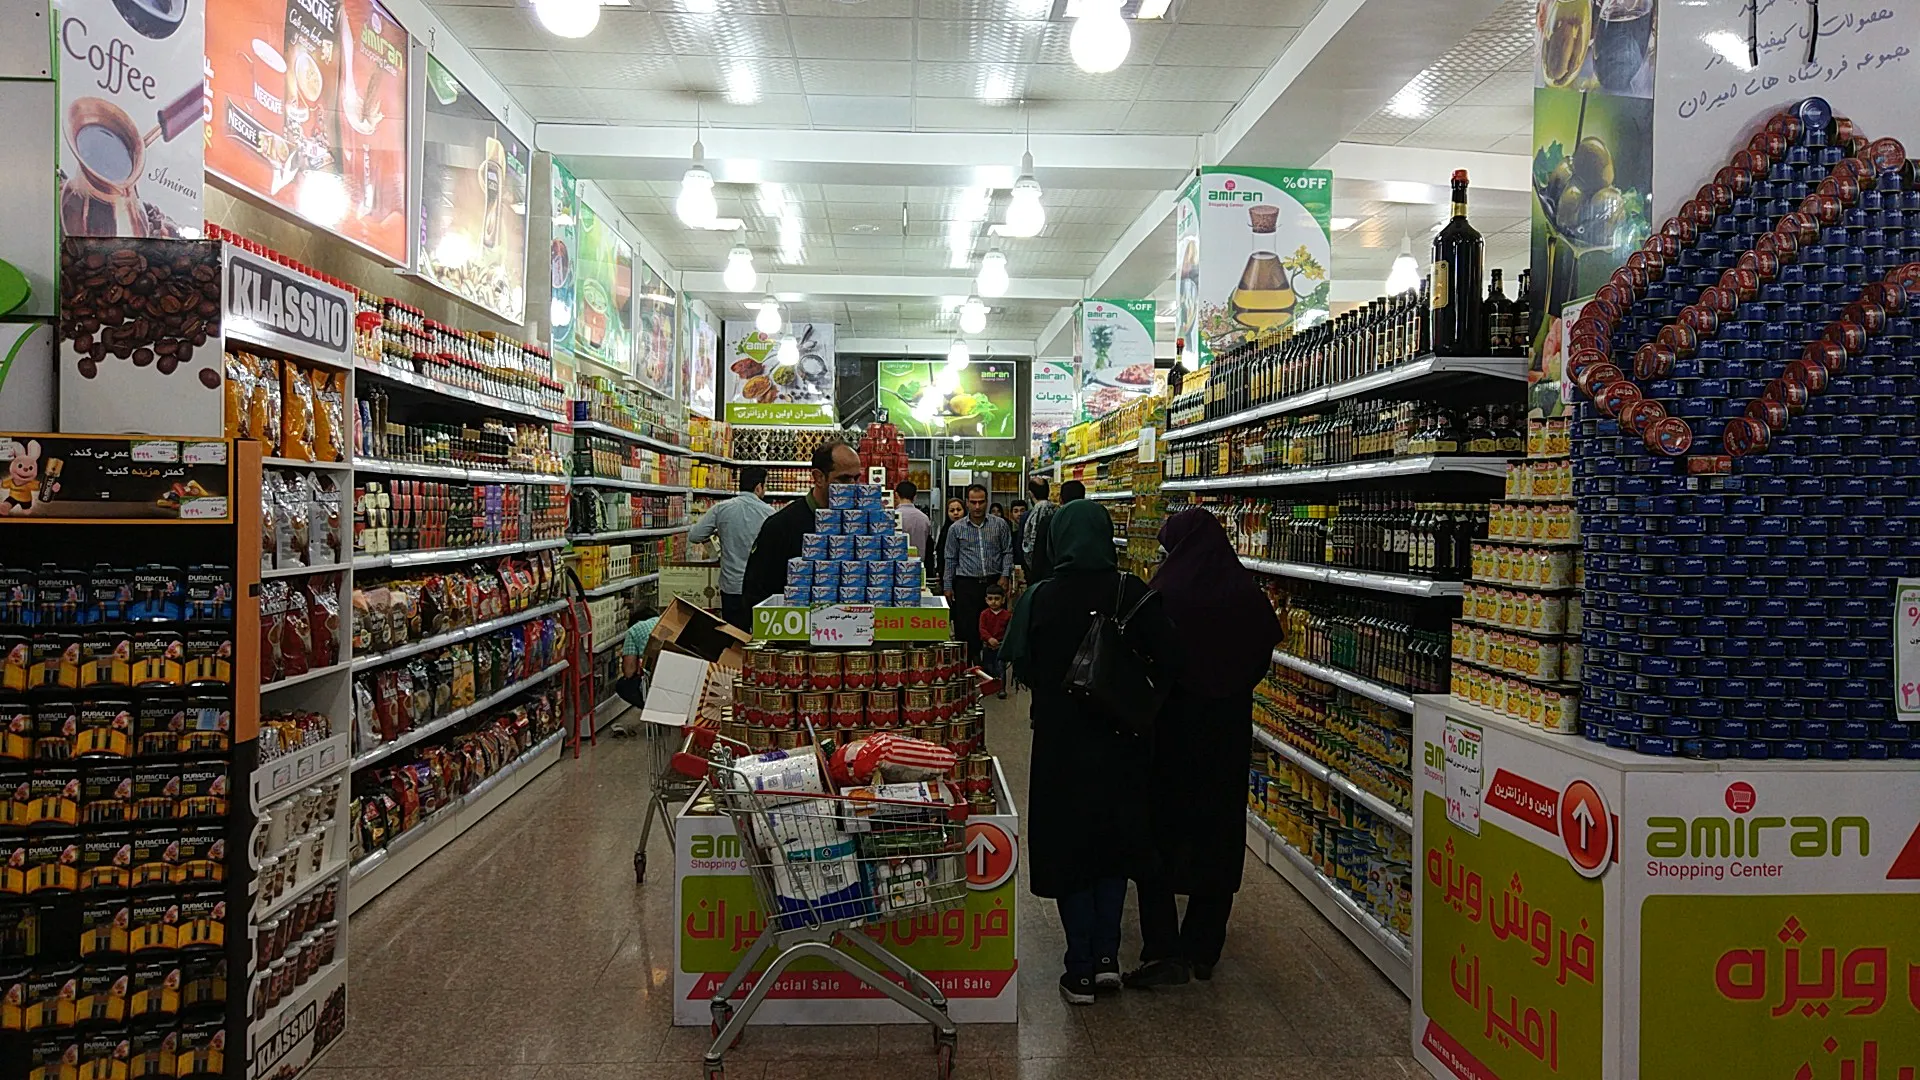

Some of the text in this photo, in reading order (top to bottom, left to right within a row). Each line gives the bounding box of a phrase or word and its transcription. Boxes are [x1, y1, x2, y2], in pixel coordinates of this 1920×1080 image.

[297, 0, 335, 34] ESCAFÉ
[62, 17, 156, 100] Coffee
[148, 167, 198, 200] Amiran
[1283, 177, 1327, 190] %OFF
[1208, 190, 1263, 202] amiran
[233, 263, 344, 347] KLASSNO
[1127, 303, 1153, 311] %OFF
[1087, 311, 1118, 319] amiran
[746, 341, 773, 351] amir
[1036, 391, 1074, 404] بوبات
[111, 450, 130, 460] عمر
[759, 610, 947, 636] %O cial Sale
[1448, 734, 1478, 760] %OFF
[1529, 801, 1535, 811] و
[1535, 802, 1555, 819] اولین
[1646, 816, 1870, 858] amiran
[85, 842, 120, 850] DURACELL
[690, 858, 737, 871] Shopping
[1646, 861, 1784, 881] Shopping Center
[133, 906, 166, 914] DURACELL
[1427, 835, 1595, 986] فروش ویژه
[1715, 915, 1888, 1019] ویژه
[770, 979, 806, 991] ecial
[812, 979, 840, 991] Sale
[963, 978, 991, 990] Sale
[1450, 943, 1558, 1073] امیران
[257, 1003, 316, 1071] KLASSNO
[1428, 1033, 1451, 1060] Amiran
